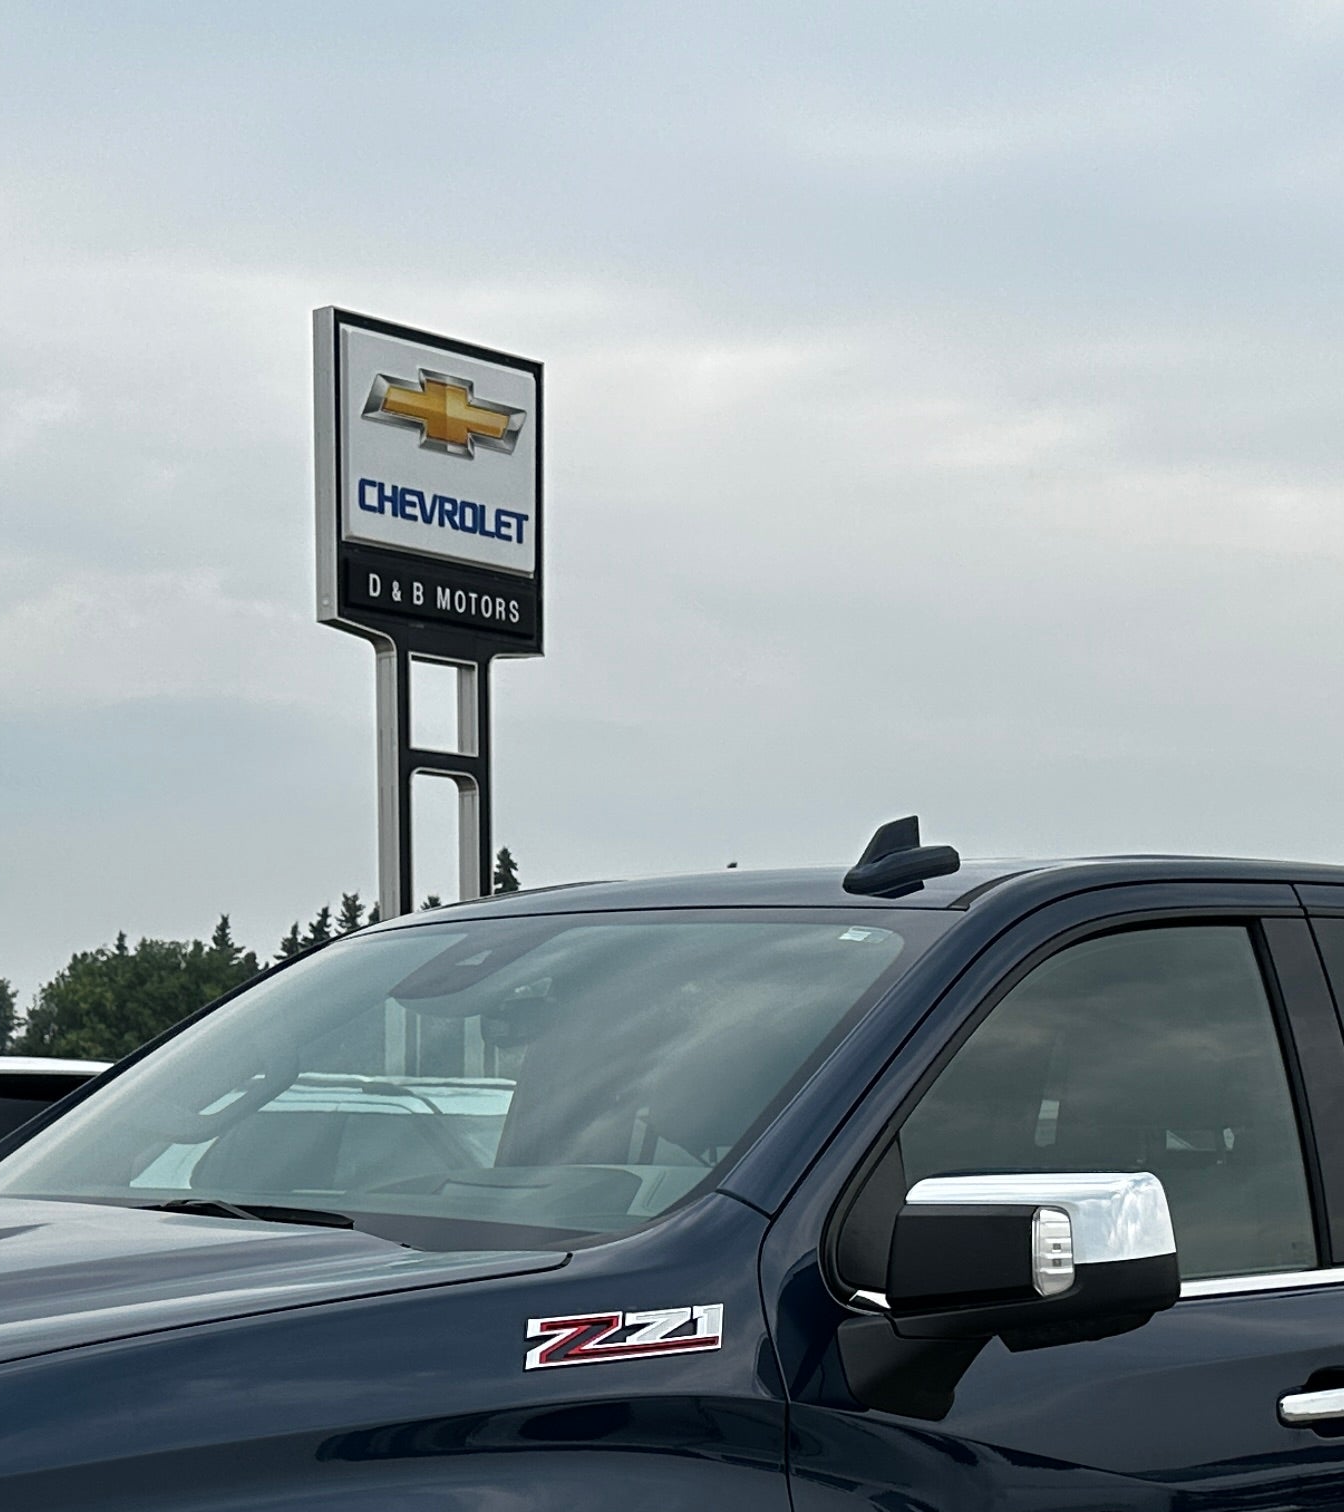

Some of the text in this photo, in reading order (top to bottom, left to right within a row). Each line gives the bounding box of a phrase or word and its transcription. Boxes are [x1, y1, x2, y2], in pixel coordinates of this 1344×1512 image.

[358, 478, 529, 544] CHEVROLET
[369, 573, 520, 623] D & B MOTORS
[525, 1303, 724, 1370] Z71
